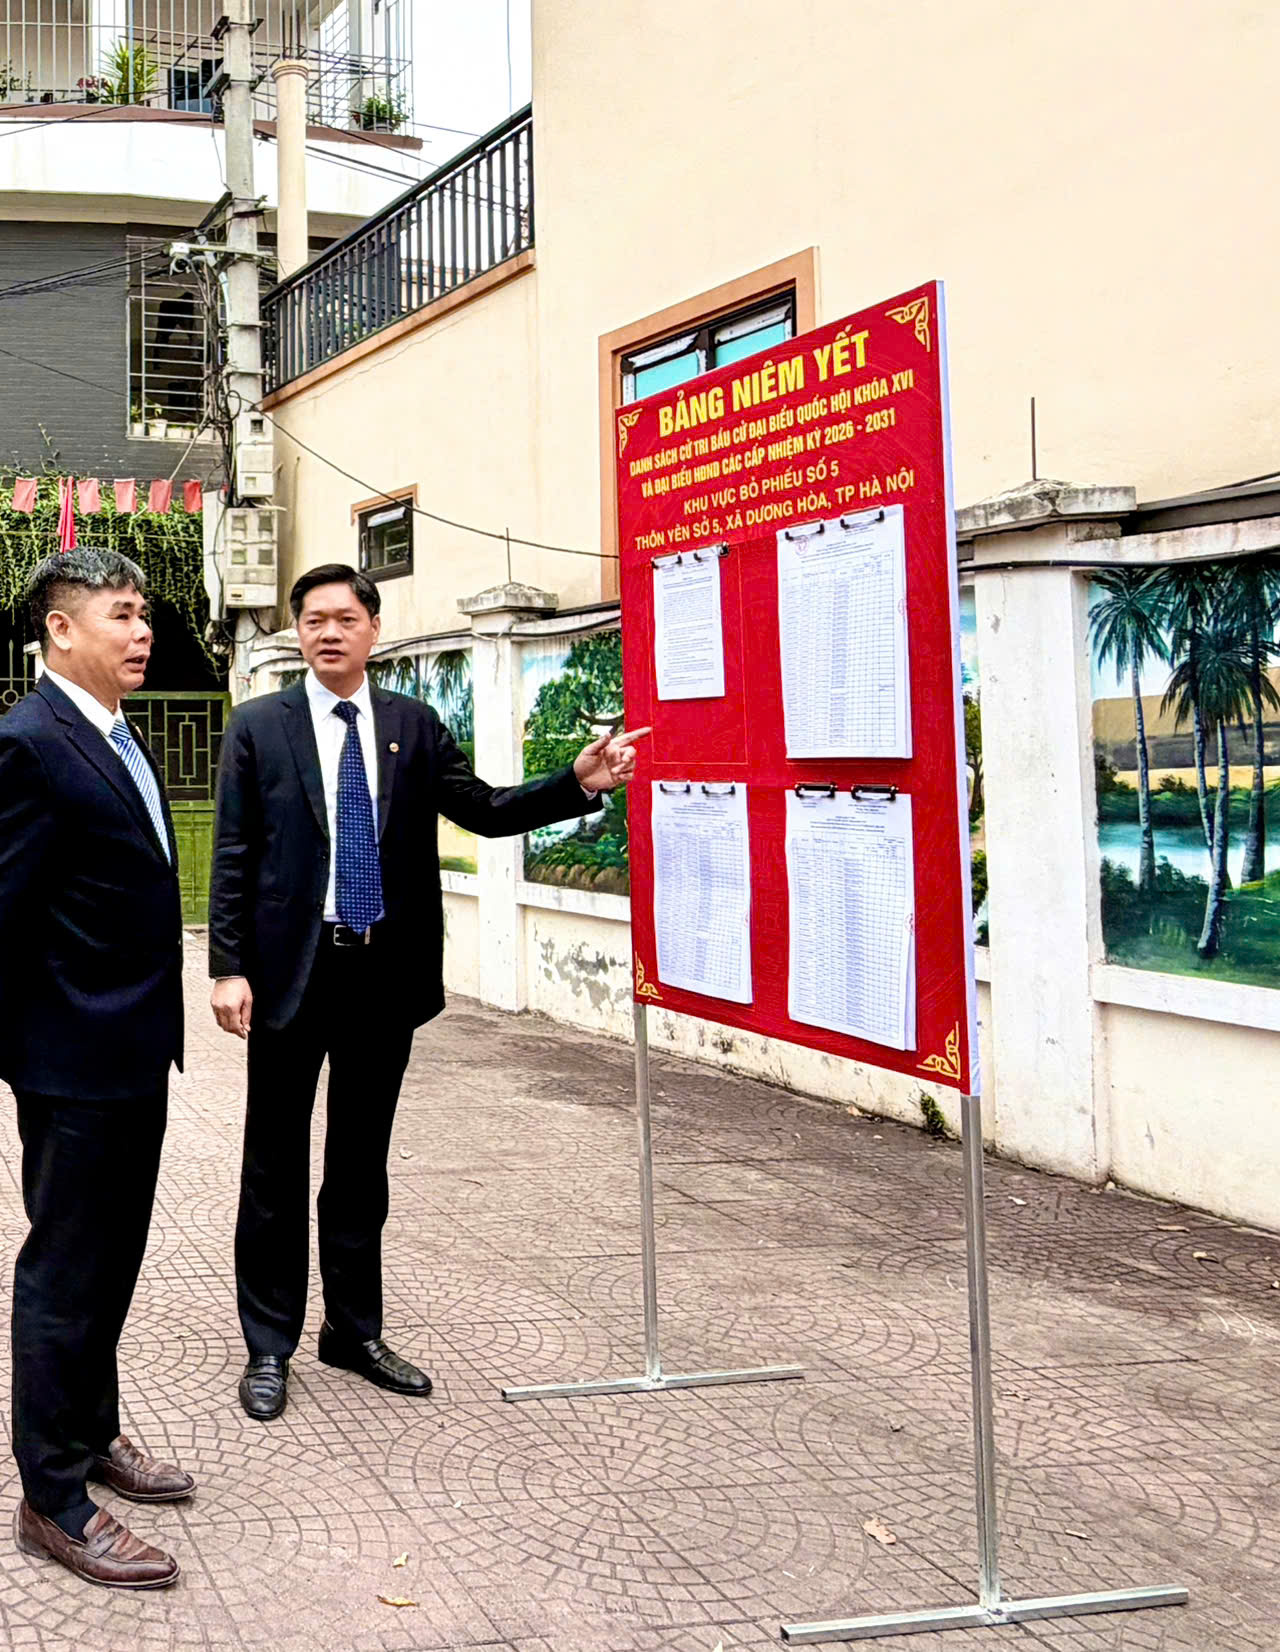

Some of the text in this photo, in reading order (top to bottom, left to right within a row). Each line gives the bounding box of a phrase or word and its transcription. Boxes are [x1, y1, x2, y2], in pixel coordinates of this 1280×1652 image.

[630, 458, 653, 477] DANH
[654, 444, 678, 470] SÁCH
[694, 438, 709, 457] TRI
[749, 418, 766, 440] ĐẠI
[797, 394, 828, 425] QUỐC
[831, 388, 852, 413] HỘI
[854, 376, 889, 405] KHÓA
[891, 369, 914, 393] XVI
[659, 324, 869, 437] BẢNG NIÊM YẾT
[641, 477, 654, 499] VÀ
[694, 461, 720, 483] HĐND
[722, 453, 743, 475] CÁC
[744, 442, 765, 468] CẤP
[768, 434, 804, 462] NHIỆM
[806, 426, 821, 451] KỲ
[824, 420, 854, 446] 2026
[865, 408, 896, 433] 2031
[683, 456, 840, 515] KHU VỰC BỎ PHIẾU SỐ 5
[635, 466, 915, 551] THÔN YÊN SỞ 5, XÃ DƯƠNG HÒA, TP HÀ NỘI
